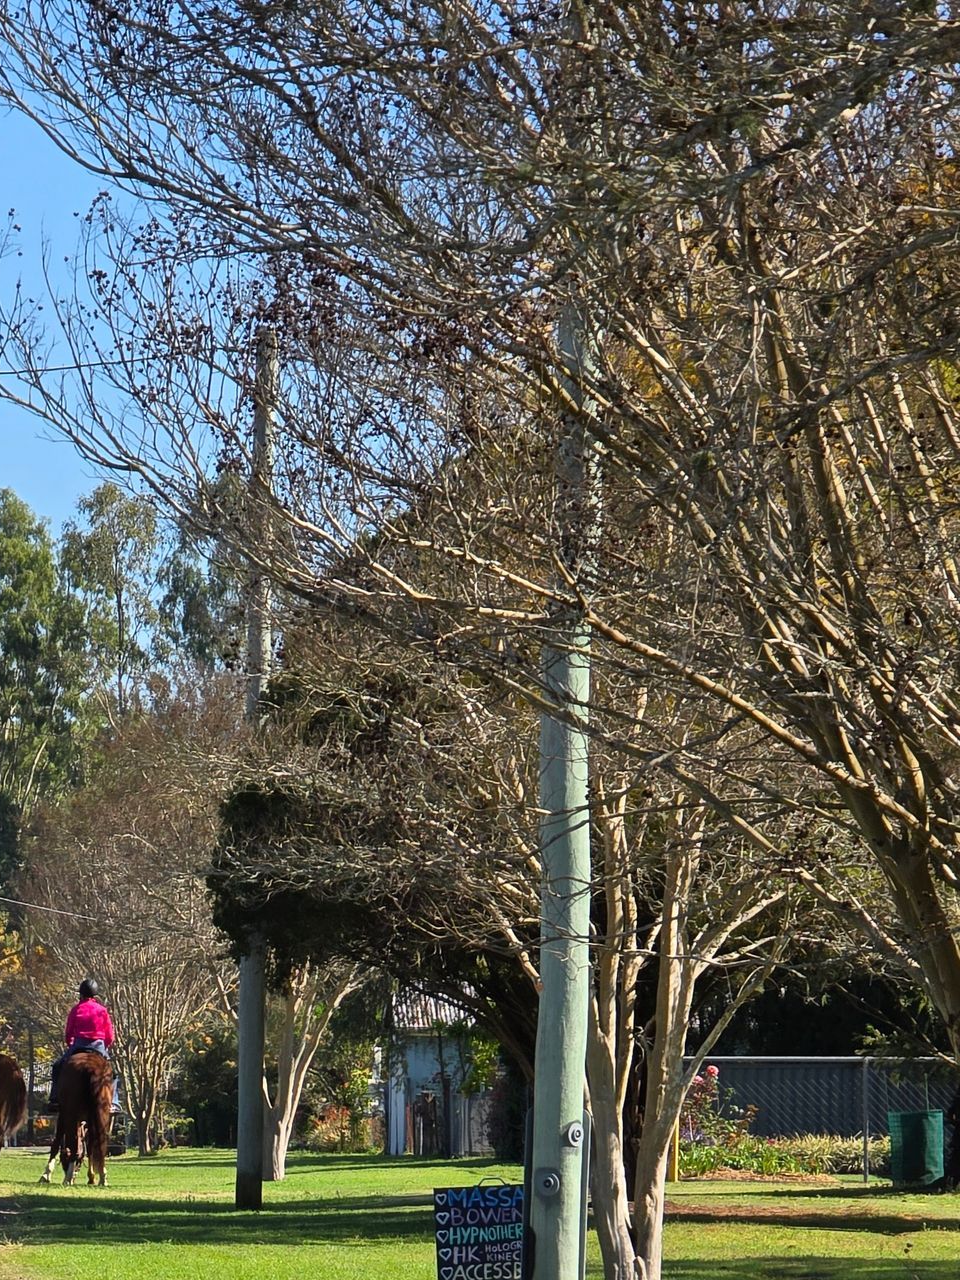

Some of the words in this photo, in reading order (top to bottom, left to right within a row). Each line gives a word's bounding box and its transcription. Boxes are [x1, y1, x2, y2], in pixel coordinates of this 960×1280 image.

[448, 1186, 524, 1208] MASSA
[451, 1207, 523, 1226] BOWEN
[450, 1223, 523, 1245] HYPNOTHER
